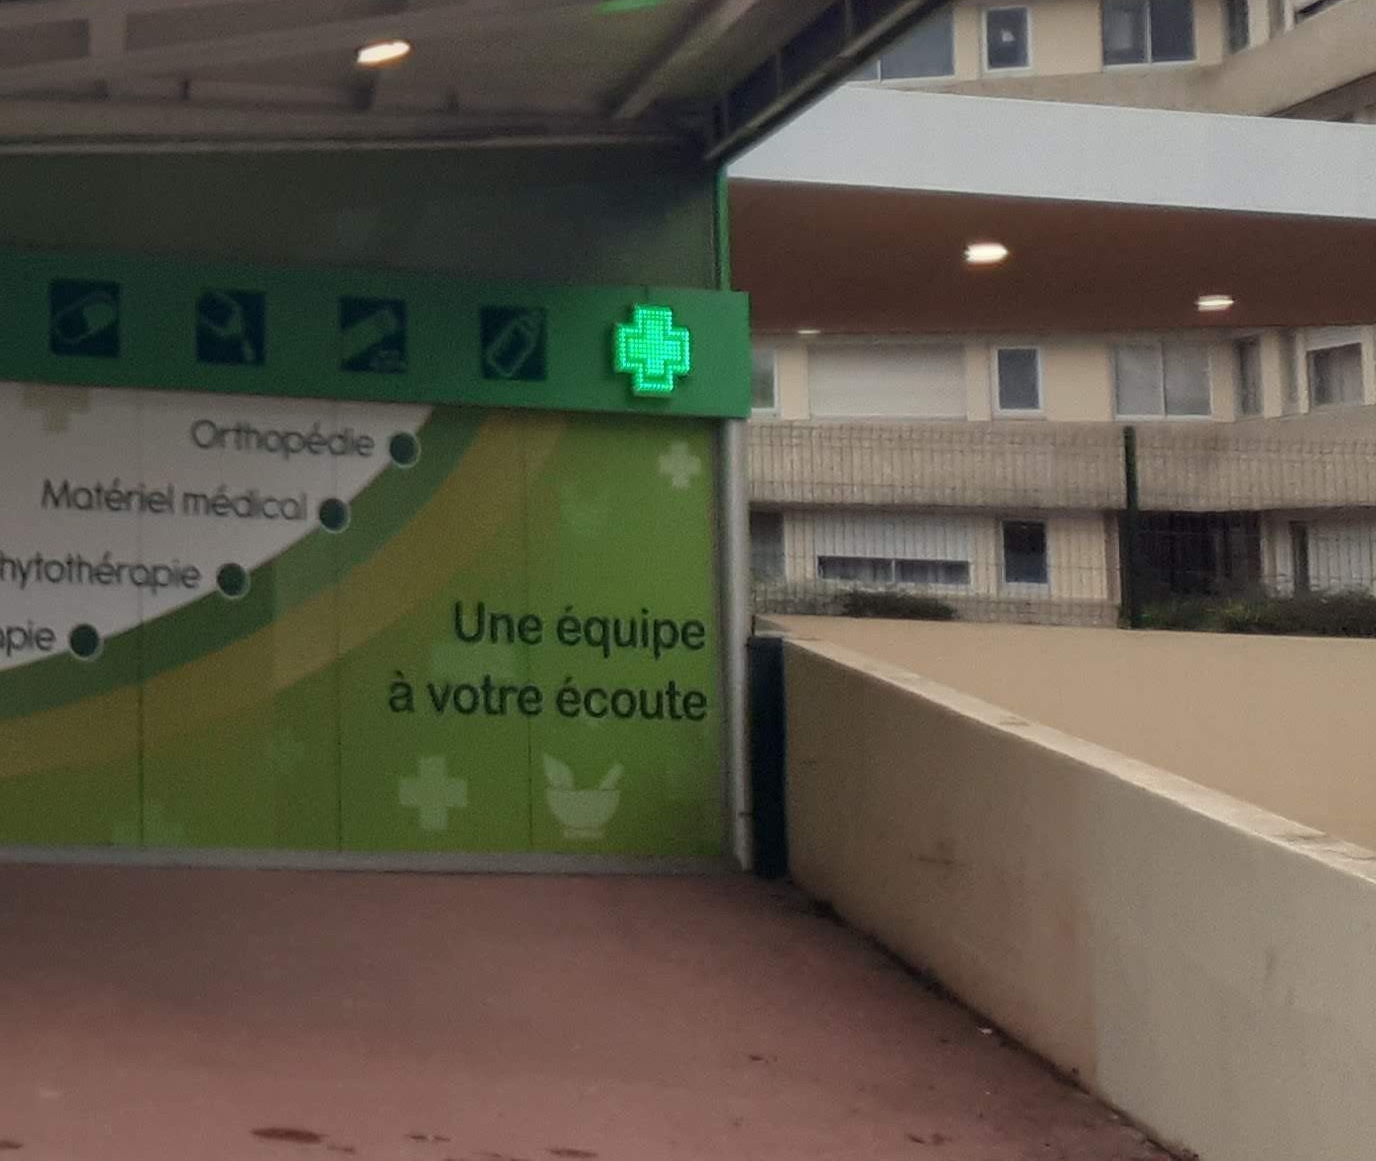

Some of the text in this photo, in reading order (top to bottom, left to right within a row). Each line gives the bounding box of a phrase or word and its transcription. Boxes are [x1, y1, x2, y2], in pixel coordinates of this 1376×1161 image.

[189, 418, 376, 458] Orthopédie
[40, 478, 308, 522] Matériel médical
[453, 600, 706, 660] Une équipe
[388, 670, 708, 722] à votre écoute
